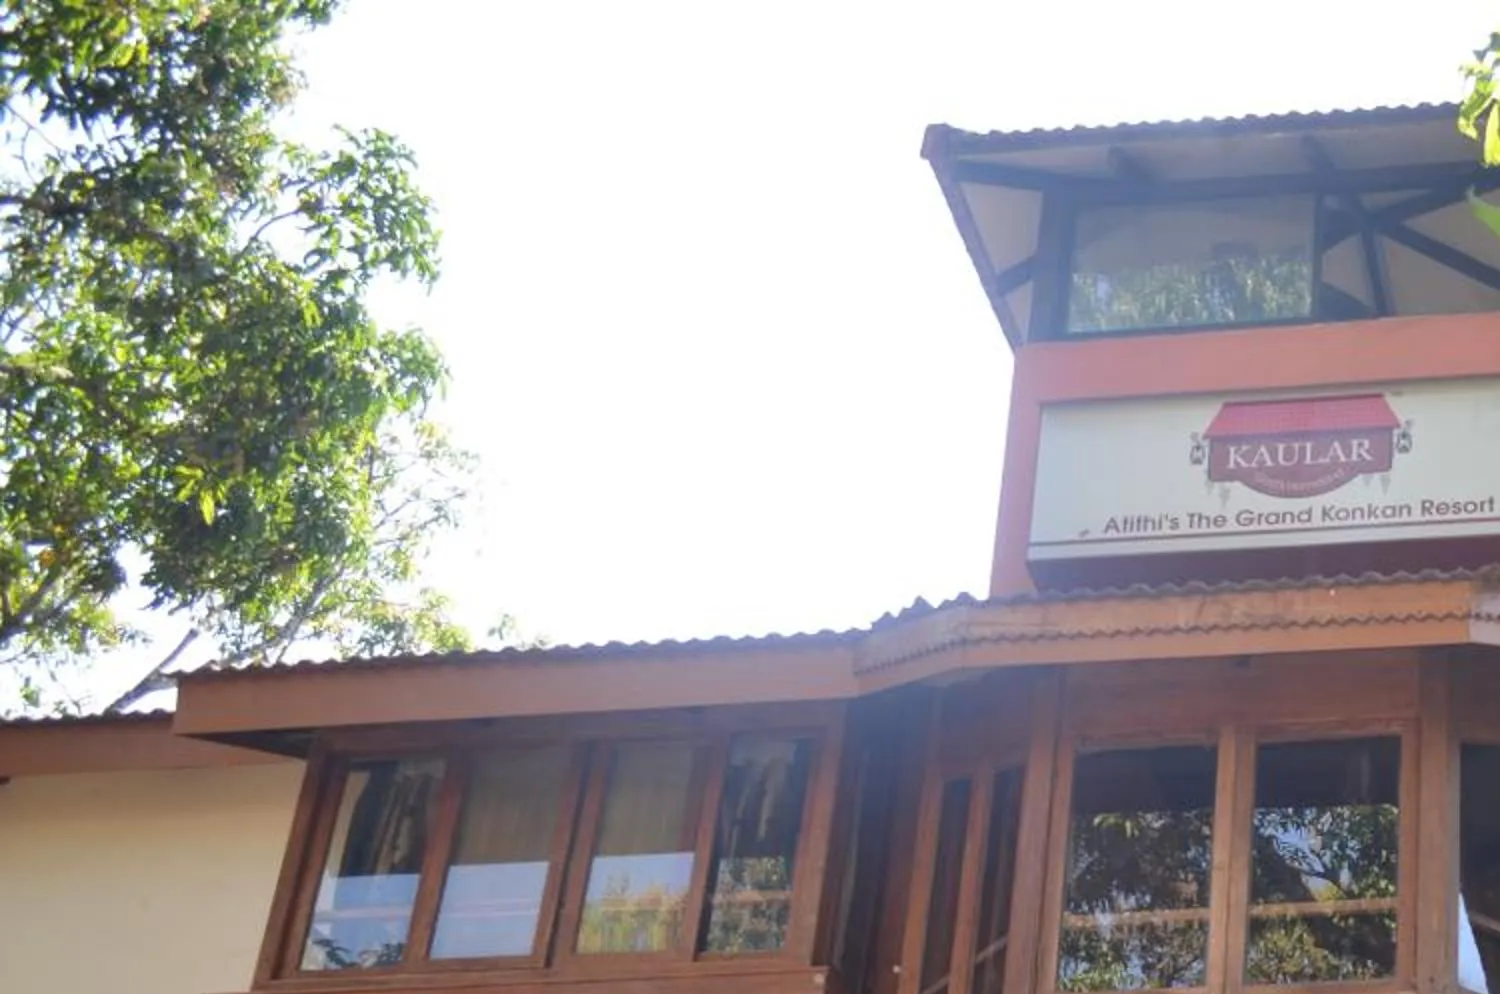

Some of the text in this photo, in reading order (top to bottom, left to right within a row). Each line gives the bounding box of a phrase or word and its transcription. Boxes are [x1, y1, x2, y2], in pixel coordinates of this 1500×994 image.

[1227, 438, 1374, 469] KAULAR
[1187, 511, 1227, 529] The
[1235, 507, 1313, 527] Grand
[1321, 503, 1412, 523] Konkan
[1420, 496, 1495, 517] Resort
